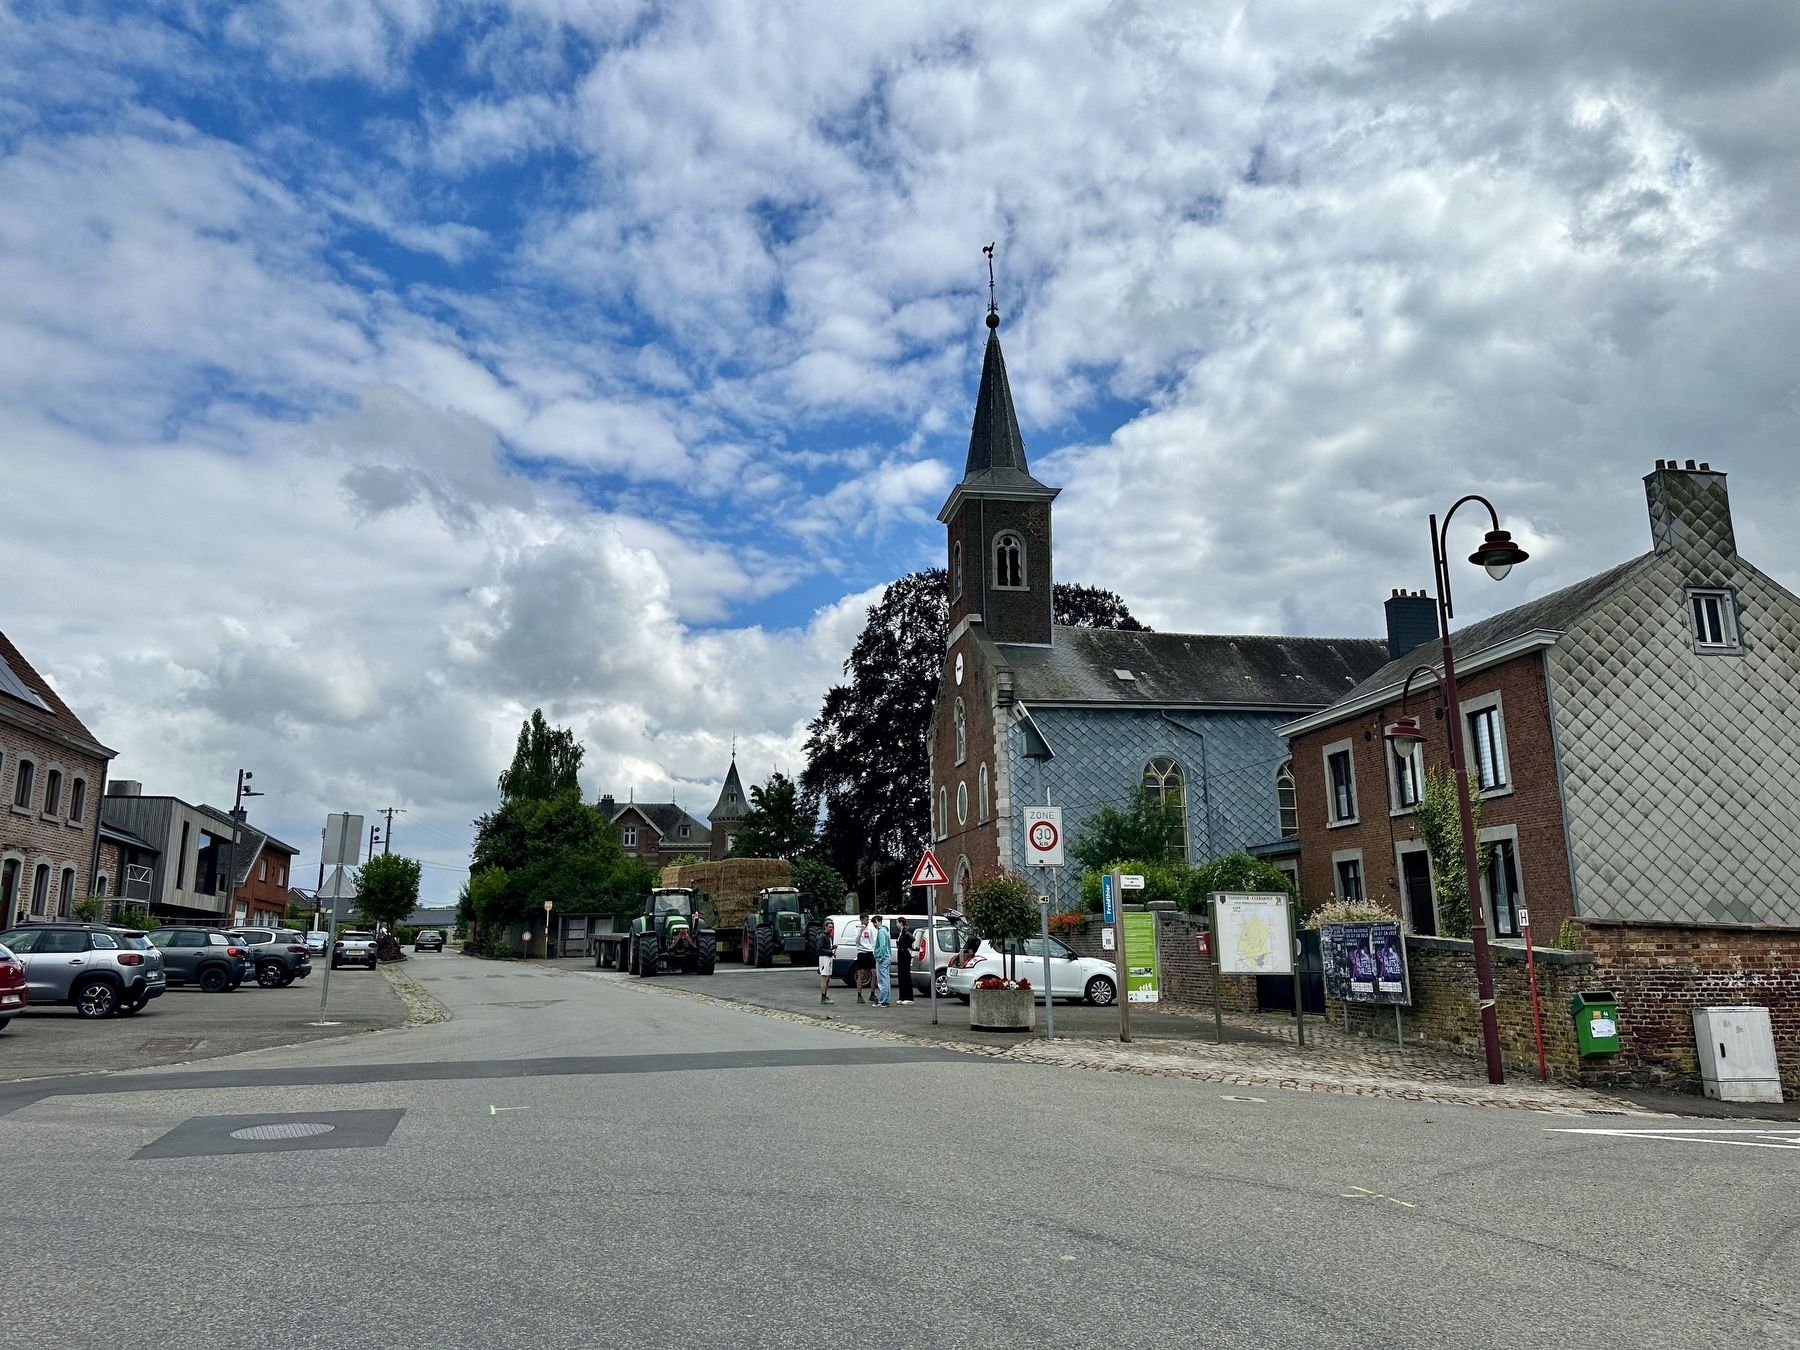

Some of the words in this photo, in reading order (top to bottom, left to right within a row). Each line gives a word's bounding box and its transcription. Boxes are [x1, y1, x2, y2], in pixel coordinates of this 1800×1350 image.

[1030, 811, 1055, 820] ZONE
[1036, 828, 1052, 840] 30
[1520, 911, 1527, 924] H
